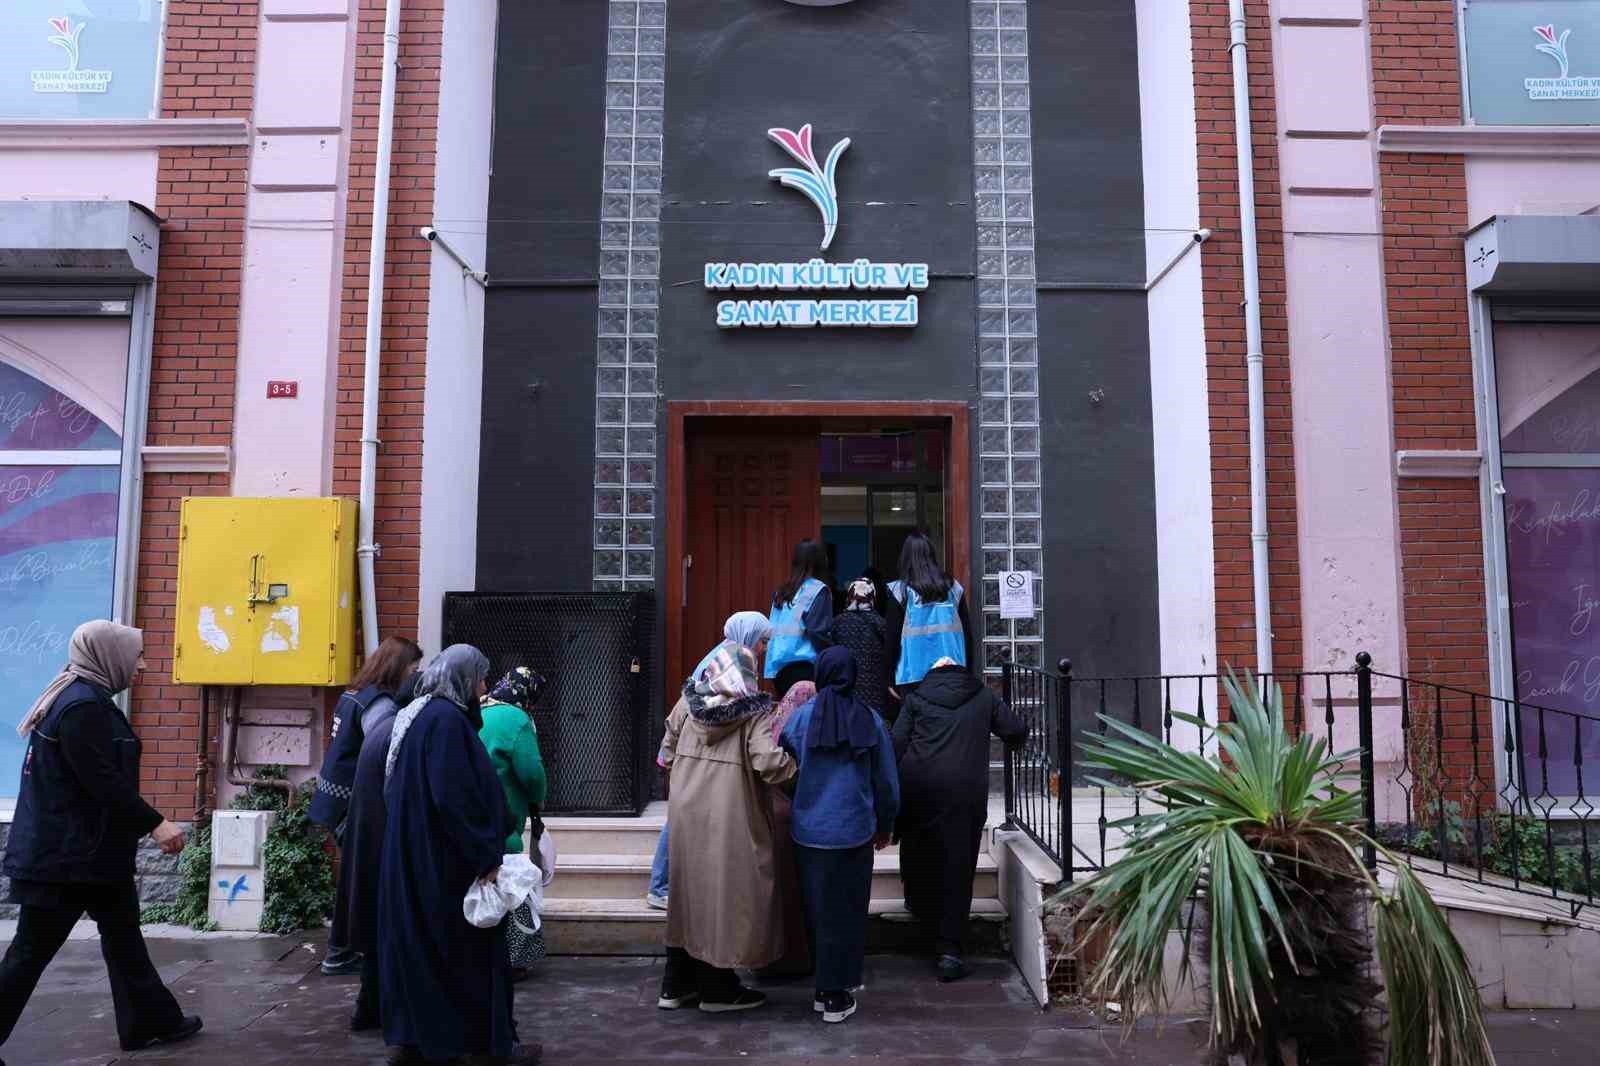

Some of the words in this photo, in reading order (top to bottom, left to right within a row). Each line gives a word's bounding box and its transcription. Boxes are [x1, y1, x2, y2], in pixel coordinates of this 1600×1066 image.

[1527, 79, 1553, 87] KADIN
[706, 264, 784, 286] KADIN
[792, 259, 887, 286] KÜLTÜR
[894, 264, 928, 286] VE
[718, 301, 801, 323] SANAT
[808, 296, 917, 323] MERKEZİ
